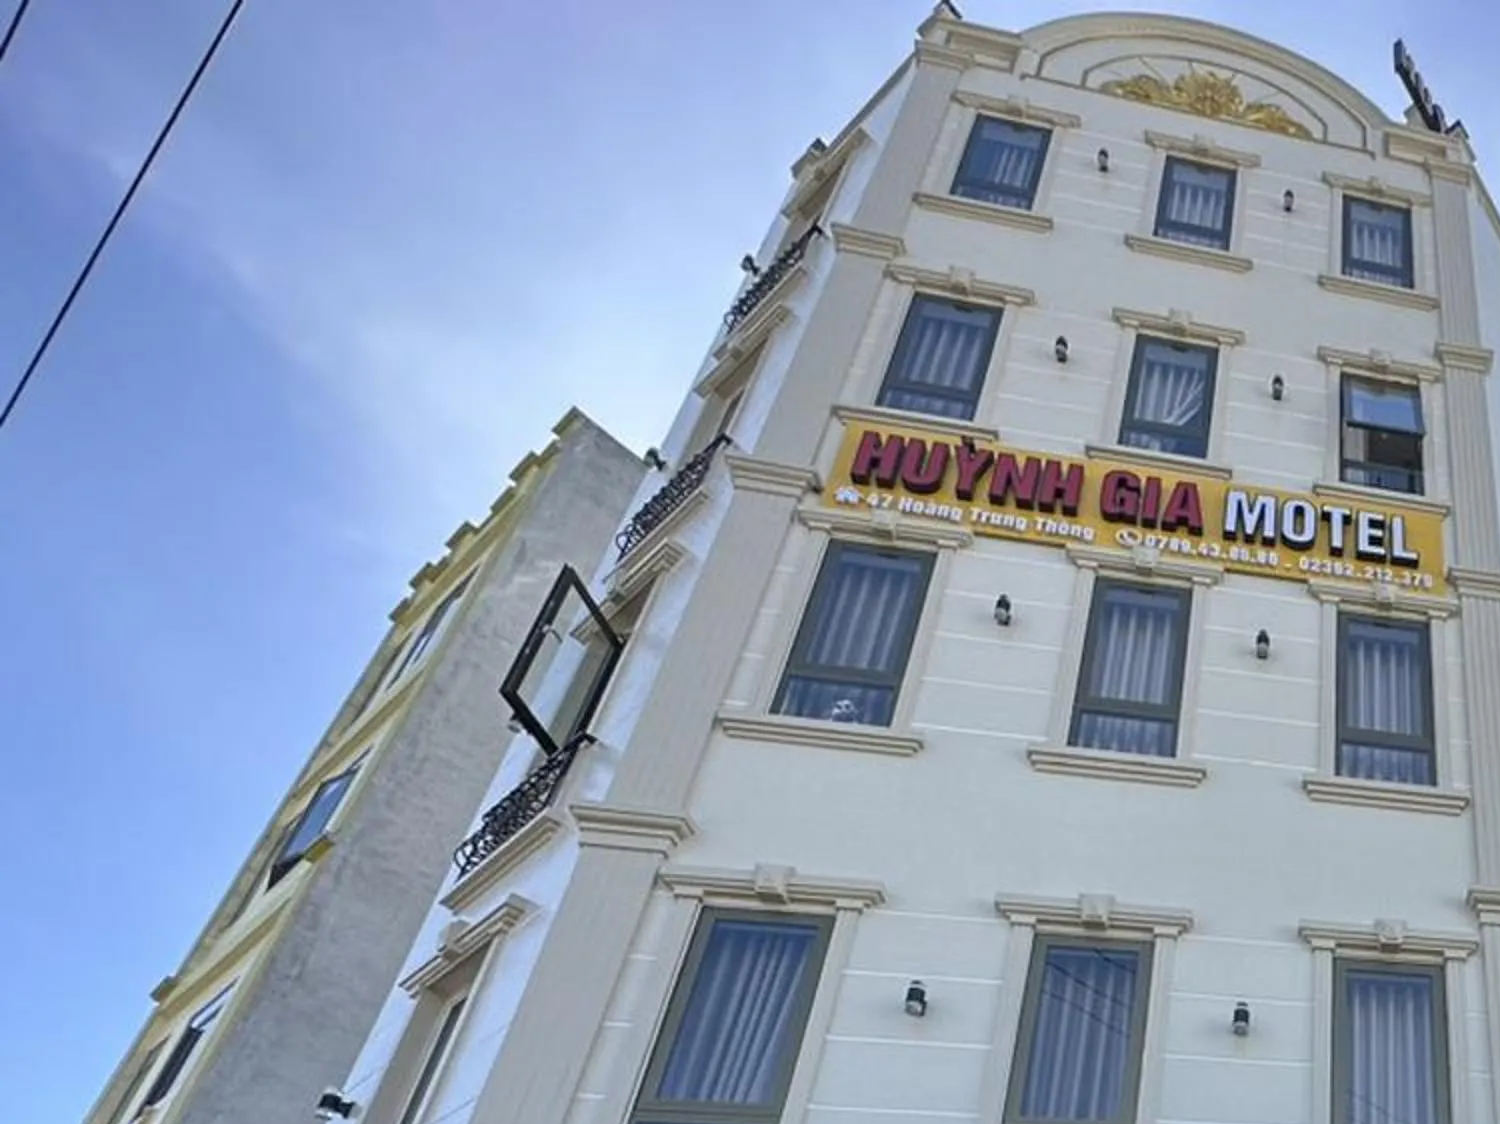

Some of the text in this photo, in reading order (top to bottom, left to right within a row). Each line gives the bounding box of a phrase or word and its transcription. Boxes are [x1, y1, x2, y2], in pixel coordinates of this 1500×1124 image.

[850, 430, 1420, 568] HUỲNH GIA MOTEL
[866, 493, 893, 509] 47
[970, 506, 1028, 530] Trung
